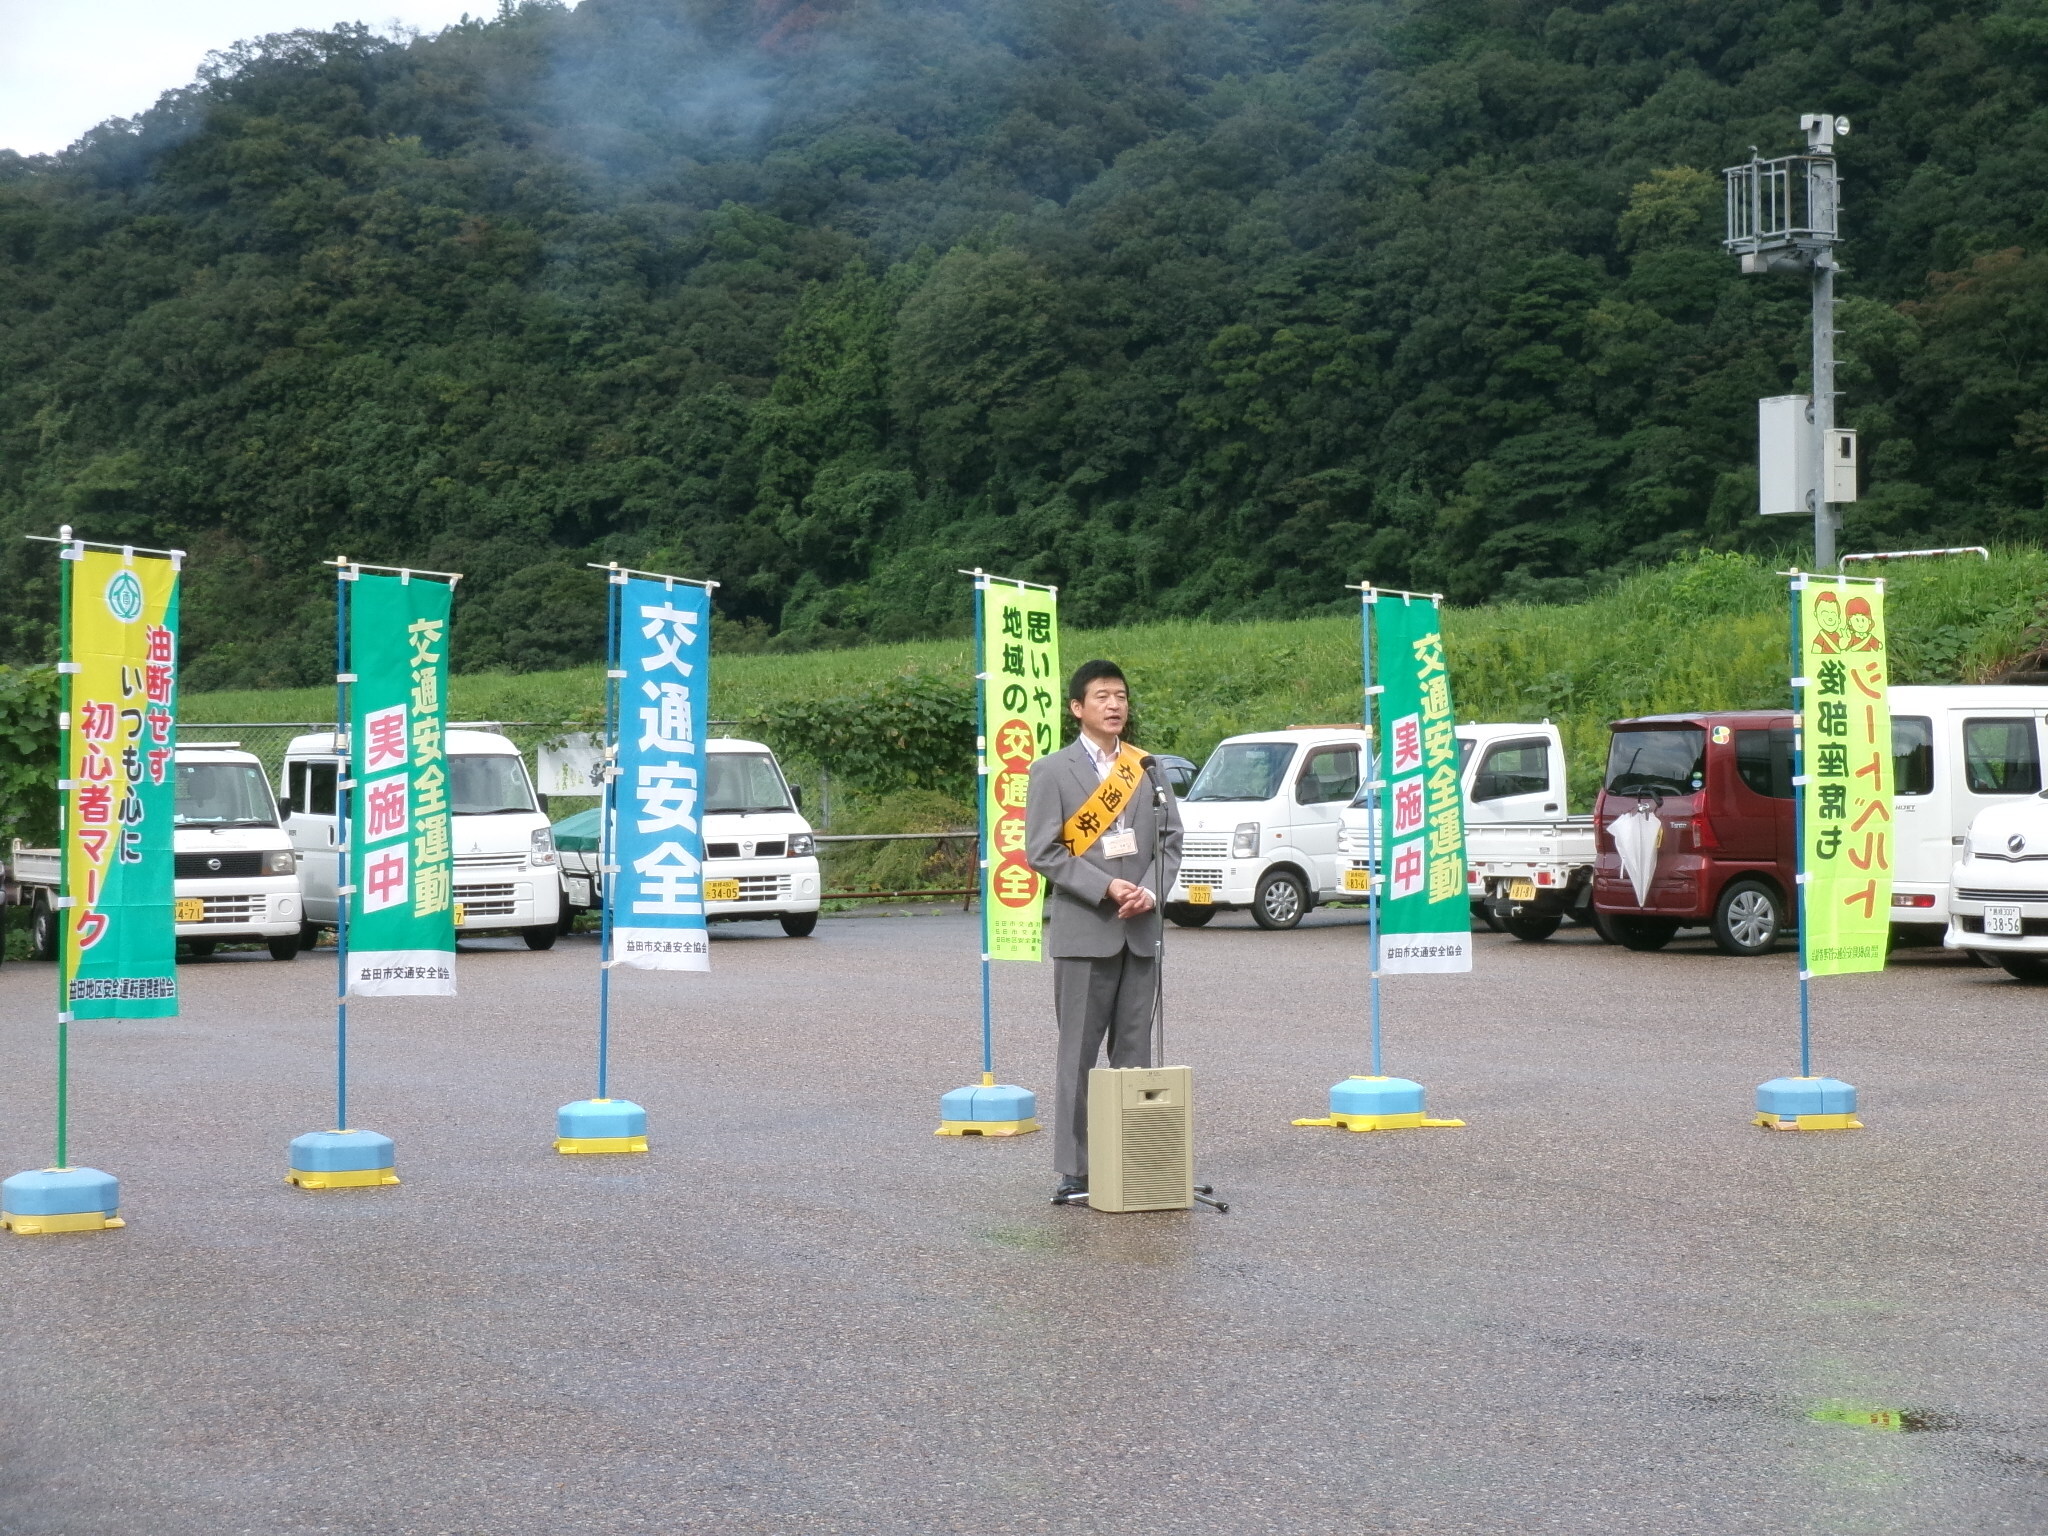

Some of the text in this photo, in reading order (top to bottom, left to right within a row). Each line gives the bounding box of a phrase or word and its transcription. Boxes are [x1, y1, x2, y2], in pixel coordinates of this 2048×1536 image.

[145, 624, 174, 785] 油断せず
[1002, 606, 1027, 714] 地域の
[1027, 611, 1052, 755] 思いやり
[76, 701, 116, 949] 初心者マーク
[119, 665, 143, 864] いつも心に
[367, 711, 406, 905] 実施中
[407, 618, 450, 918] 交通安全運動
[632, 602, 702, 915] 交通安全
[999, 727, 1033, 899] 交通安全
[1393, 721, 1424, 892] 実施中
[1412, 632, 1463, 905] 交通安全運動
[360, 966, 450, 981] 益田市交通安全協会
[626, 940, 707, 954] 益田市交通安全協会
[711, 888, 738, 899] 34-05
[1387, 944, 1463, 960] 益田市交通安全協会
[1992, 917, 2020, 931] 38-56
[69, 977, 176, 1000] 益田地区安全運転管理者協会
